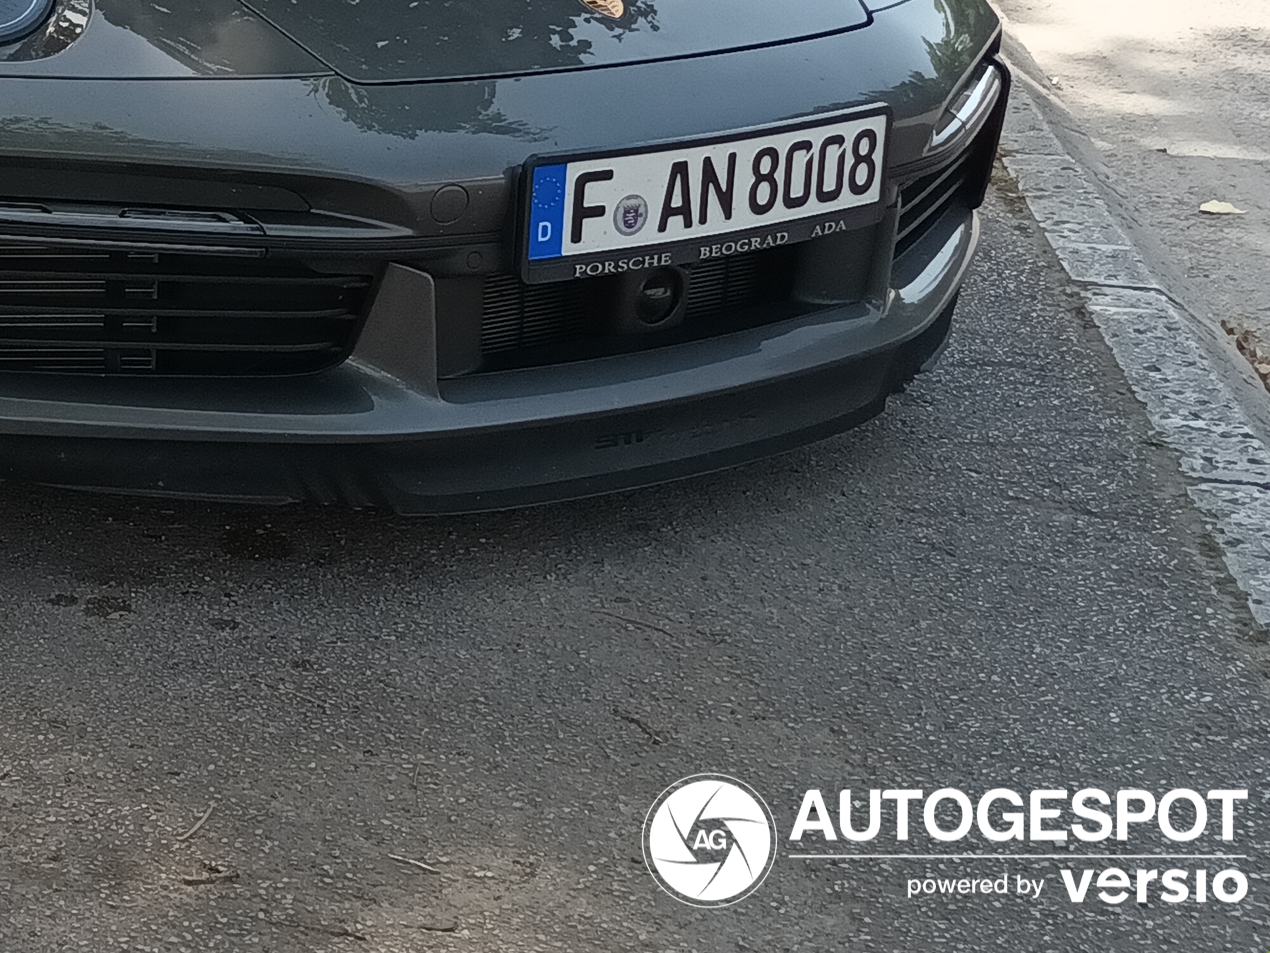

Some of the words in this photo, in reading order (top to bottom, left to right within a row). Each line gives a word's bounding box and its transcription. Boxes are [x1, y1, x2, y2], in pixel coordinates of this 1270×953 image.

[571, 169, 614, 243] F
[658, 152, 736, 232] AN
[748, 129, 877, 215] 8008
[538, 221, 552, 243] D
[574, 252, 673, 278] PORSCHE
[698, 231, 790, 261] BEOGRAD
[811, 219, 848, 239] ADA
